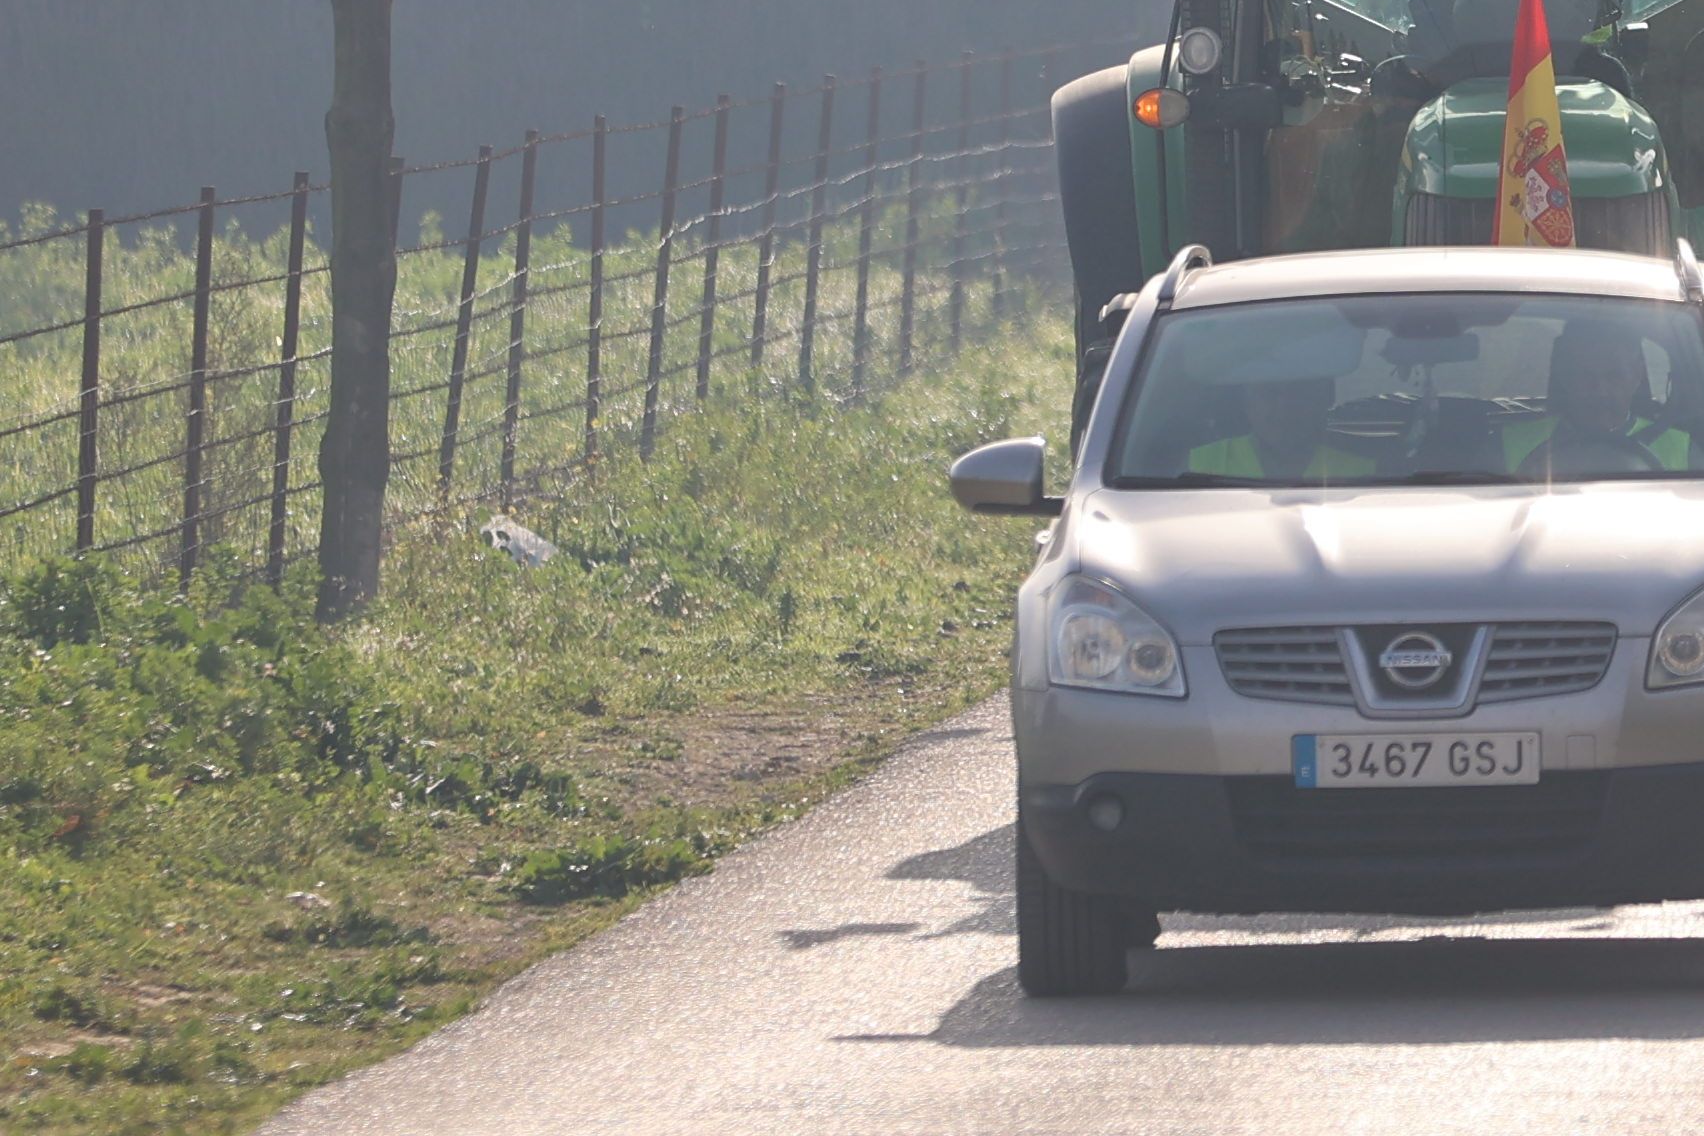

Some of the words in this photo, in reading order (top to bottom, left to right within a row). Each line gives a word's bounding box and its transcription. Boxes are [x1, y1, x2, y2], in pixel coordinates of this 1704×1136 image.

[1385, 653, 1449, 666] NISSAN
[1331, 742, 1433, 778] 3467
[1449, 739, 1523, 777] GSJ
